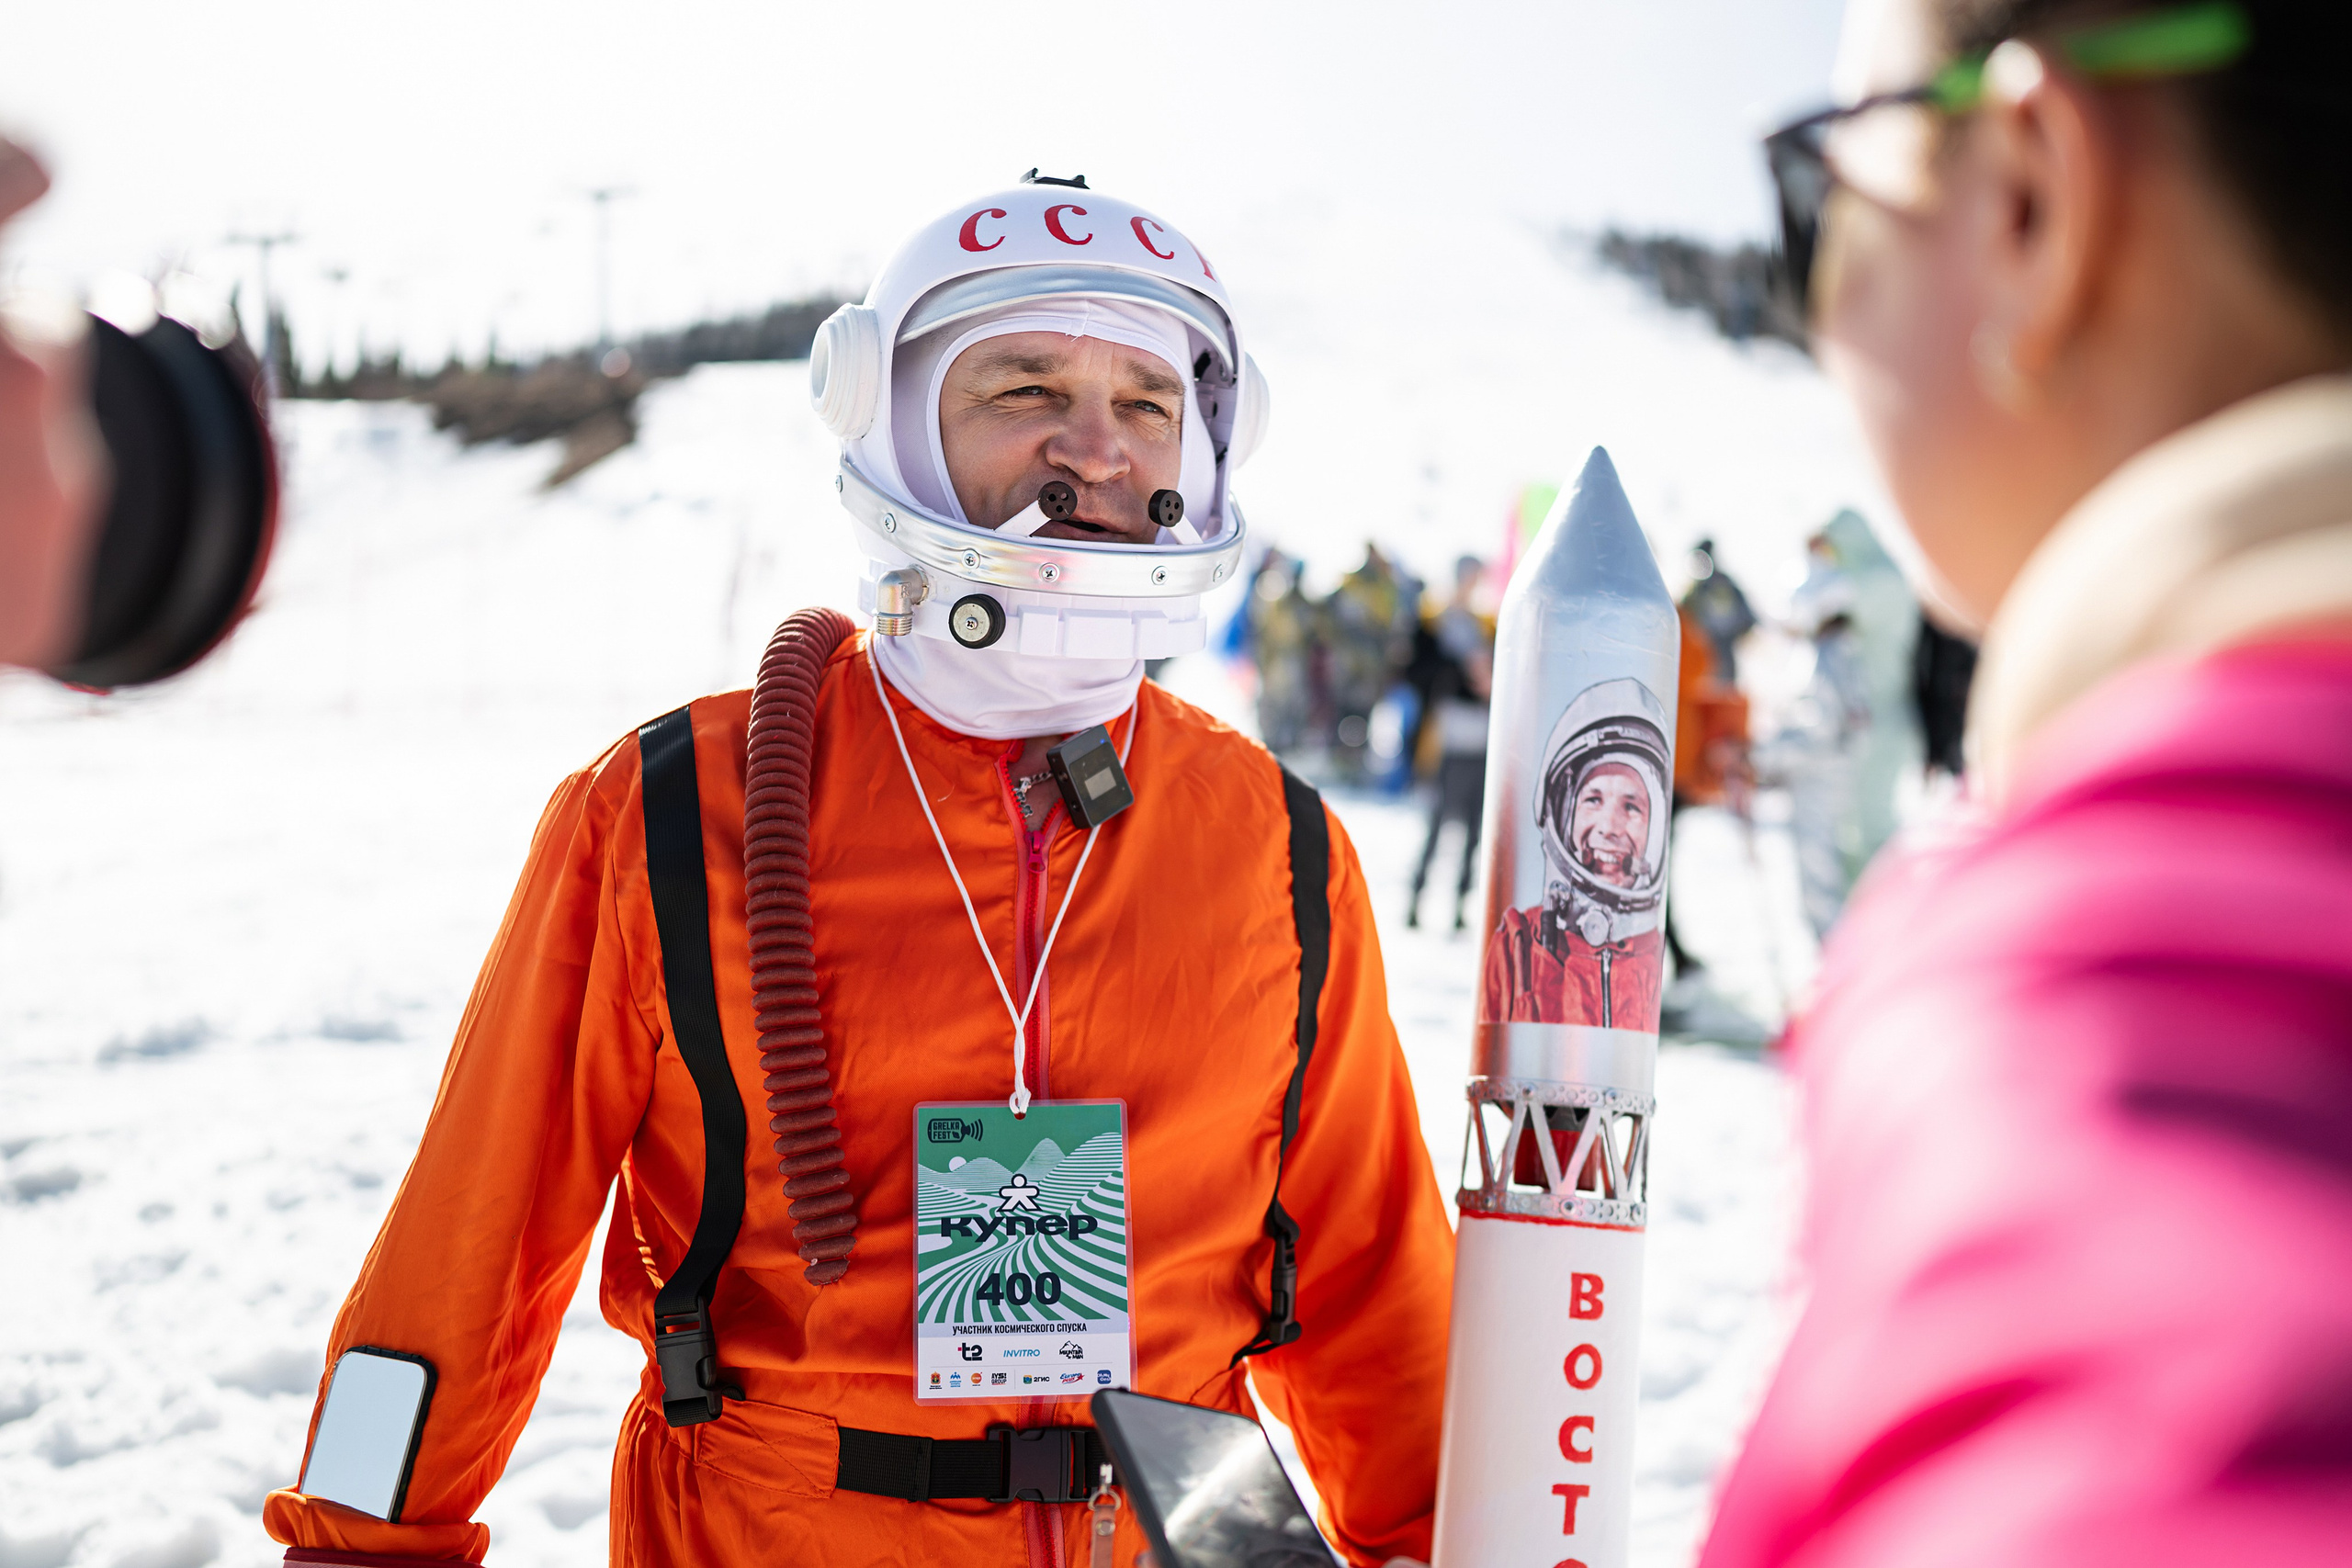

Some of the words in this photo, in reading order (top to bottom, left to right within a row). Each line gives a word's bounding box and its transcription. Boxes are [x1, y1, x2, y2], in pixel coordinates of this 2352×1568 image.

[933, 1122, 960, 1131] GRELKA
[933, 1131, 952, 1140] FEST
[976, 1271, 1062, 1306] 400
[953, 1325, 993, 1337] УЧАСТНИК
[995, 1324, 1055, 1335] КОСМИЧЕСКОГО
[1057, 1323, 1088, 1333] СПУСКА
[1002, 1349, 1041, 1359] INVITRO
[1552, 1271, 1604, 1568] ВОСТ
